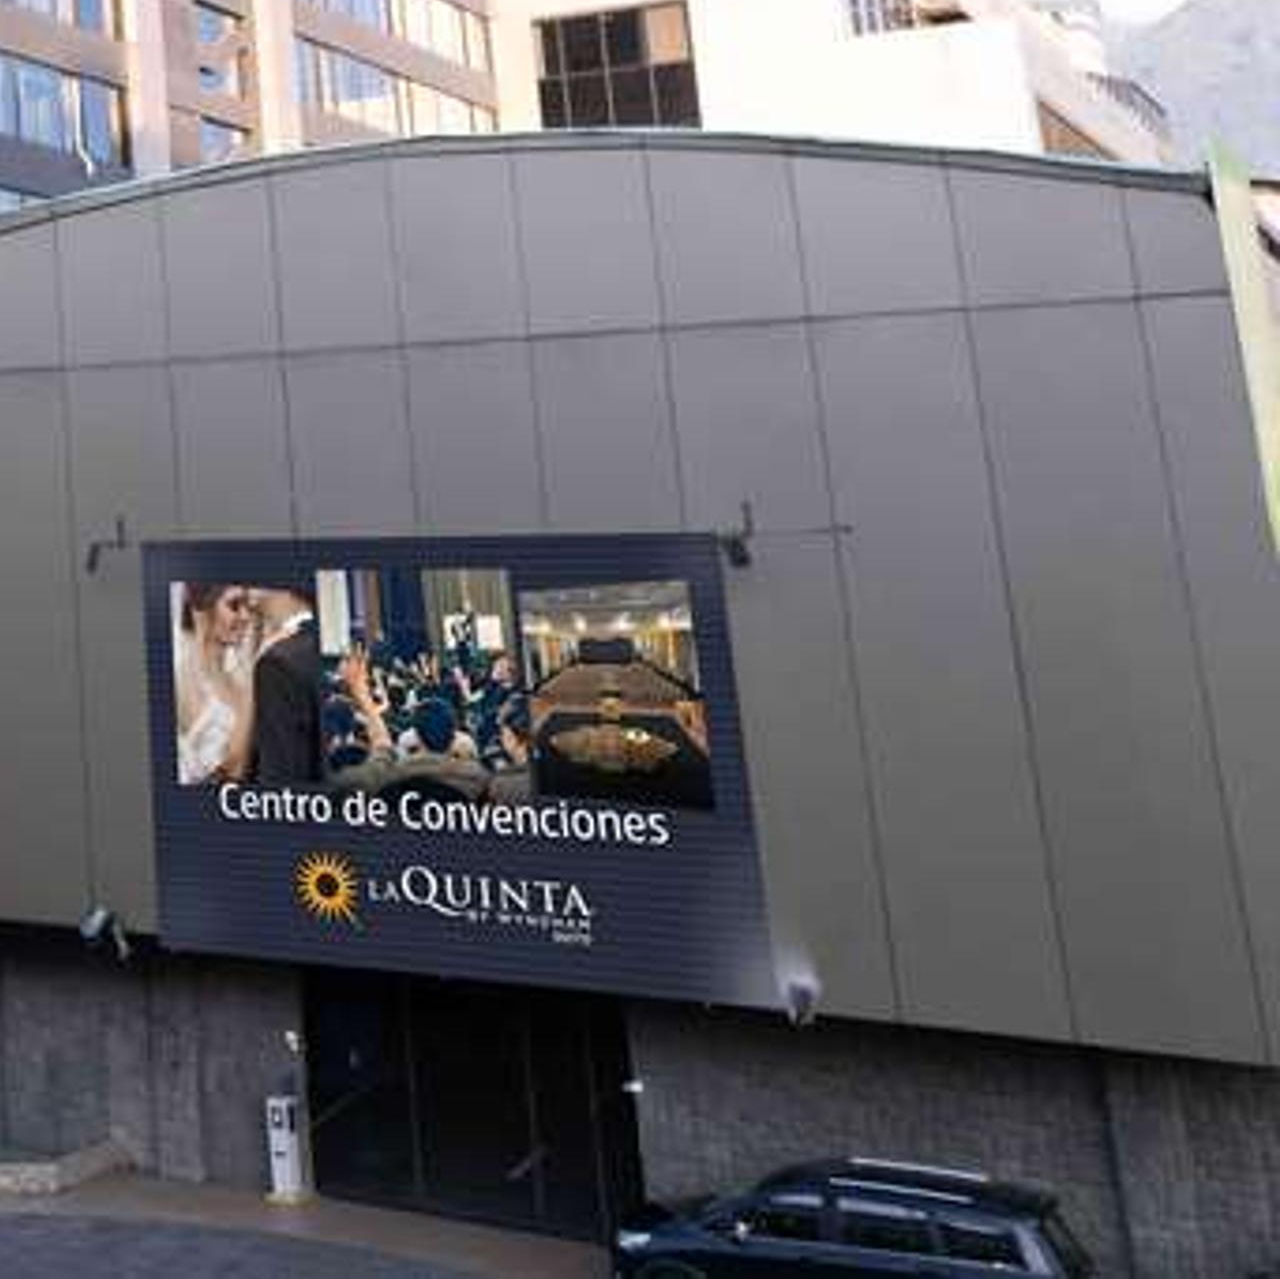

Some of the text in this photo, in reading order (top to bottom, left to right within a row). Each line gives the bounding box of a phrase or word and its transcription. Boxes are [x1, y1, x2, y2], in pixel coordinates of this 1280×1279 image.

[218, 782, 670, 845] Centro de Convenciones
